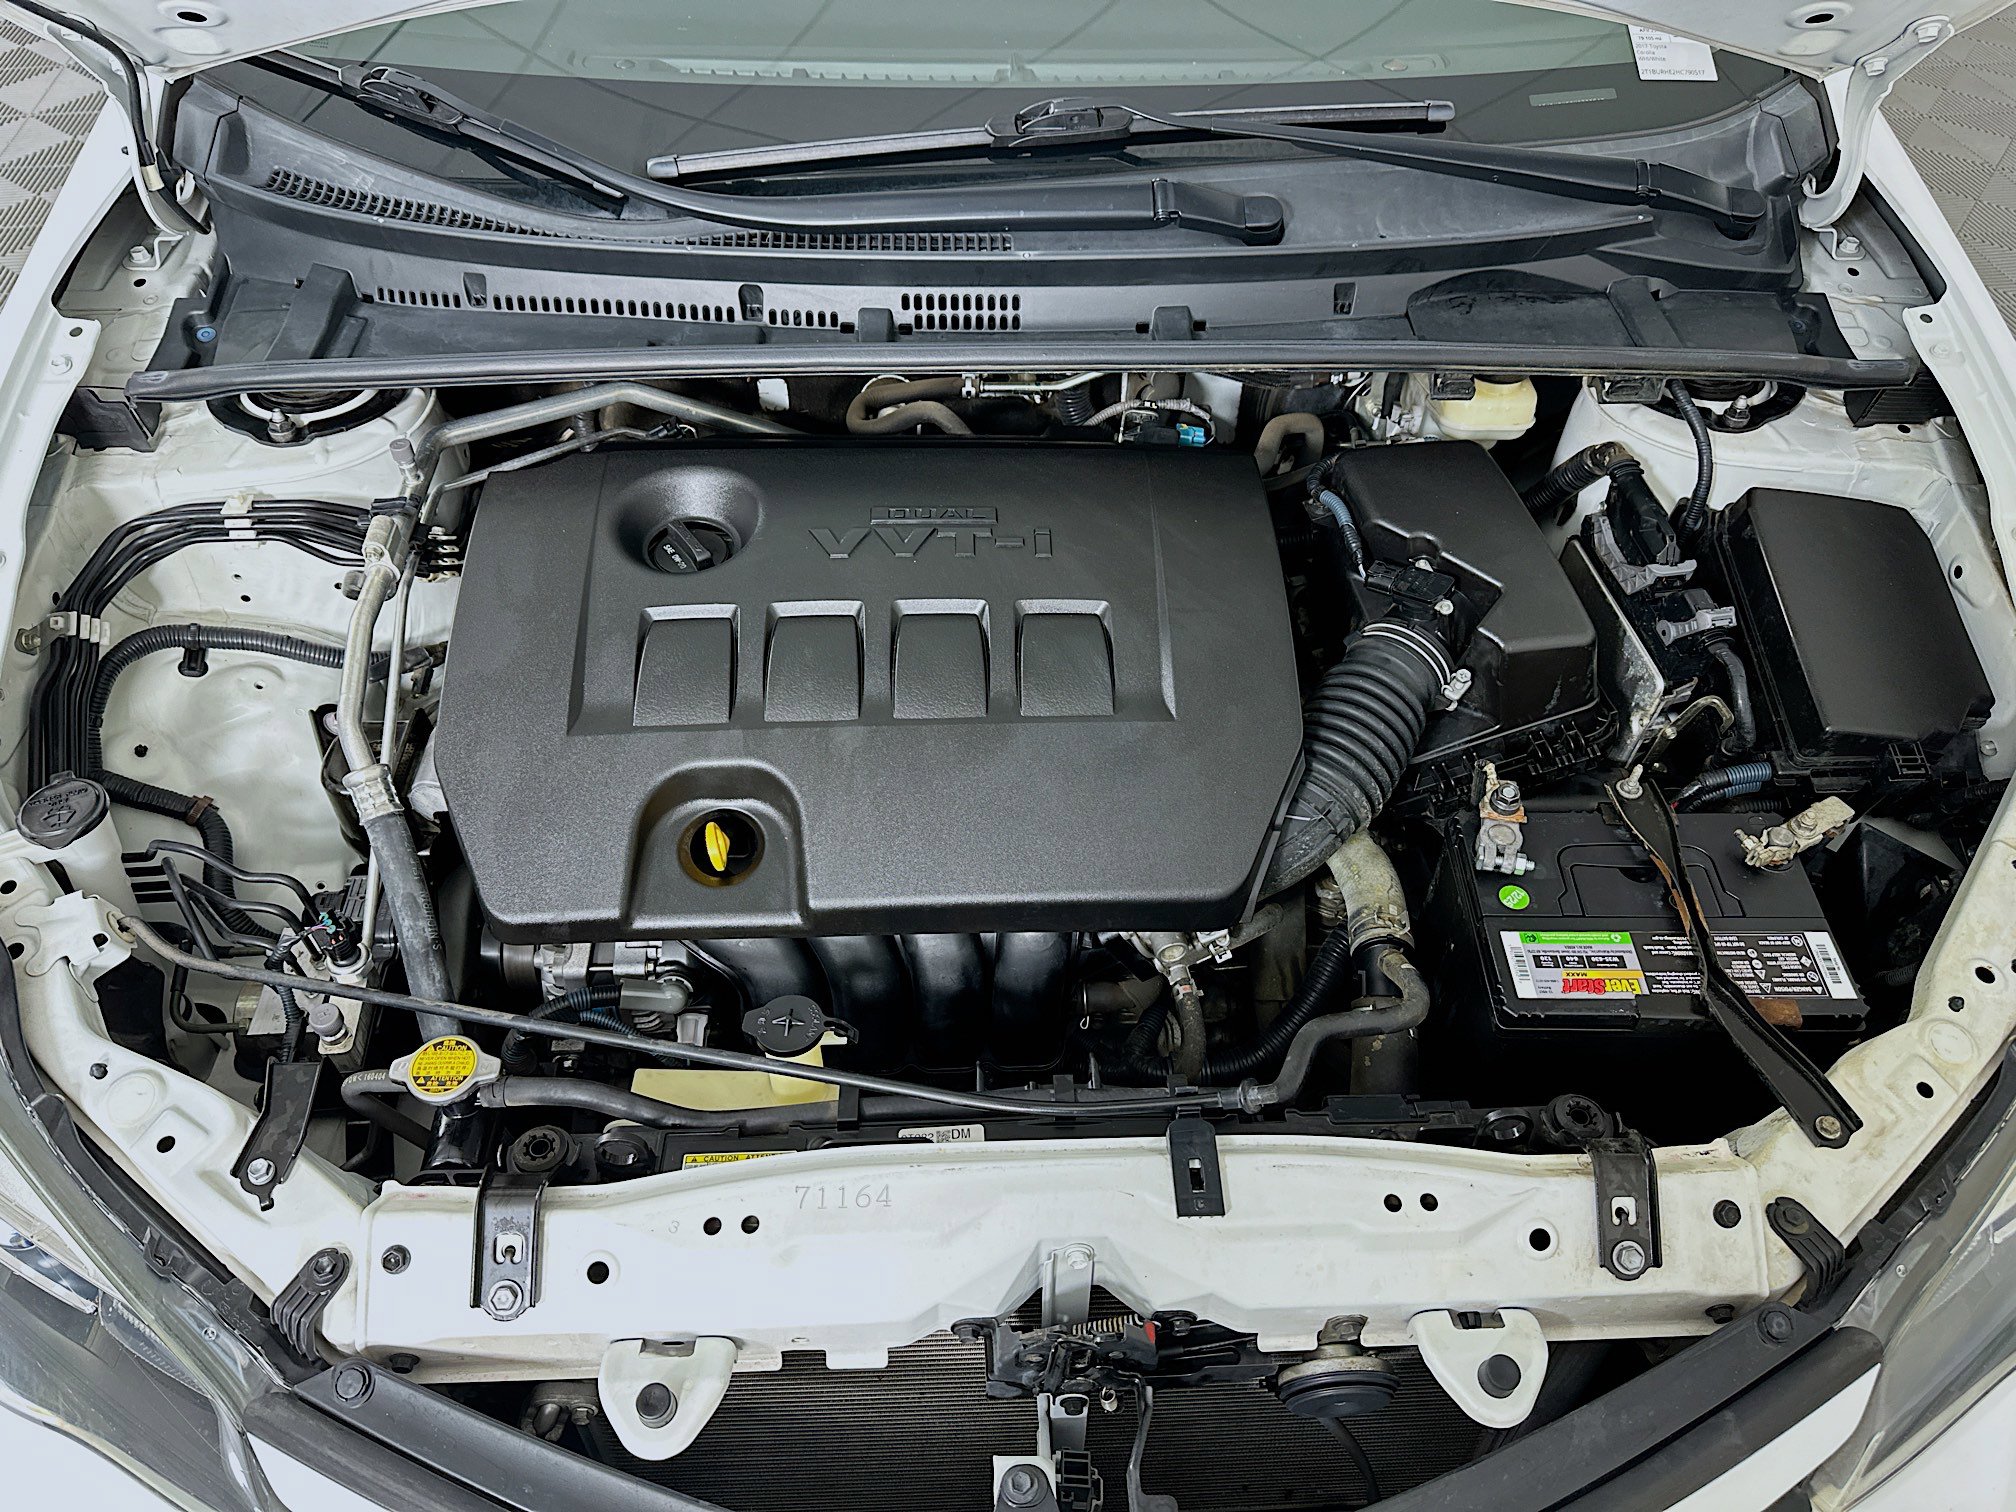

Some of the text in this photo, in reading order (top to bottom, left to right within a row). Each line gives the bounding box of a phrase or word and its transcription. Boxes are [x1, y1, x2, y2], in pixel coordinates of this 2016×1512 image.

[888, 507, 988, 519] DUAL
[662, 544, 676, 555] SAE
[808, 527, 1053, 559] VVT-i
[1562, 978, 1642, 995] EverStart
[952, 1128, 970, 1139] DM
[794, 1184, 892, 1210] 71164
